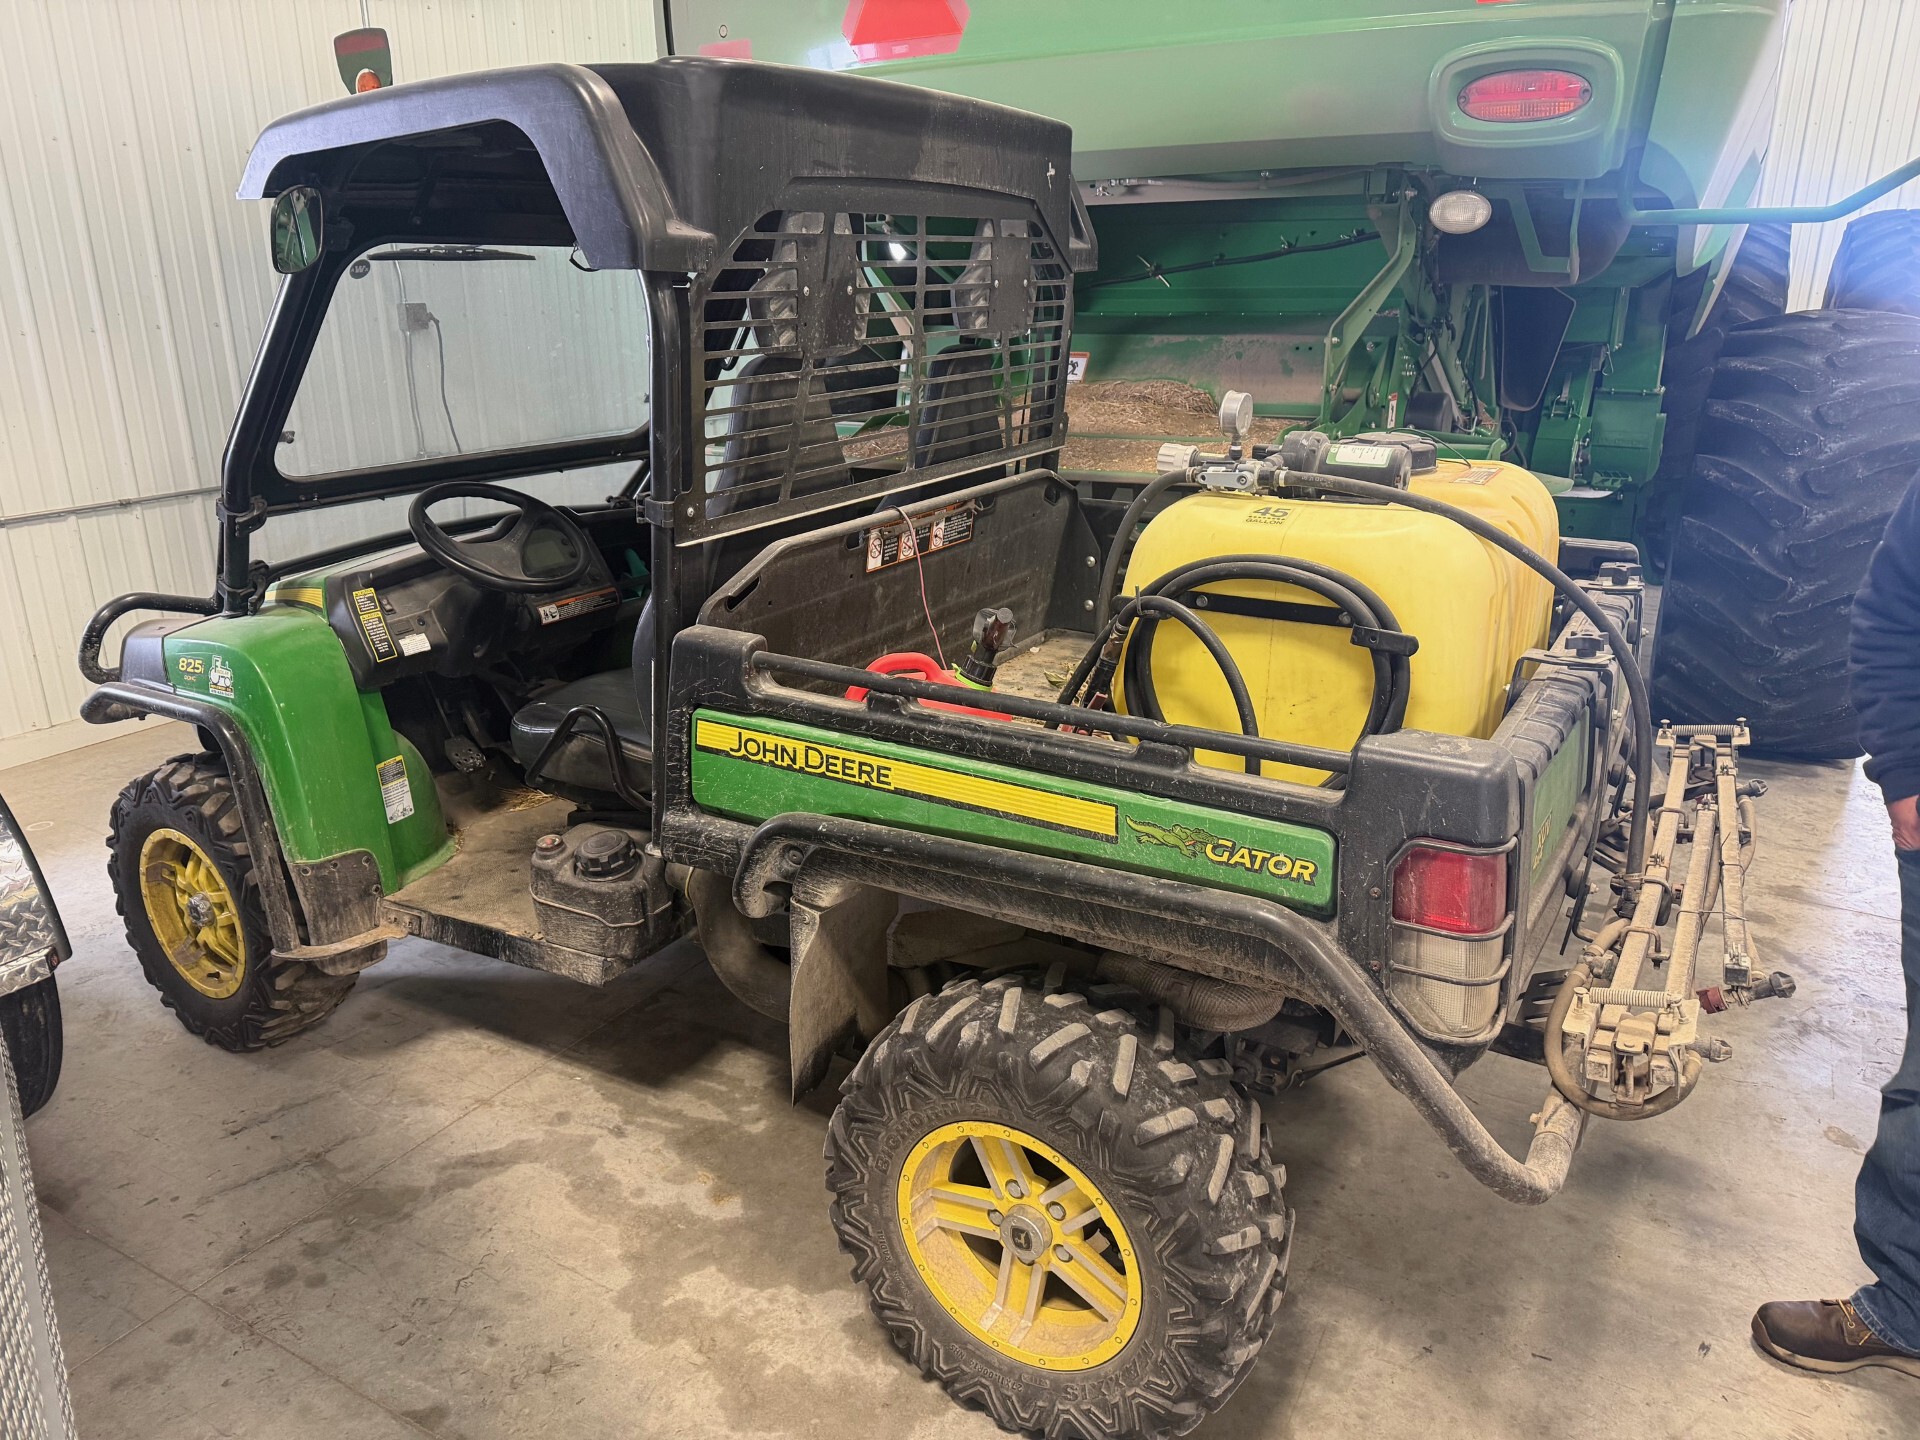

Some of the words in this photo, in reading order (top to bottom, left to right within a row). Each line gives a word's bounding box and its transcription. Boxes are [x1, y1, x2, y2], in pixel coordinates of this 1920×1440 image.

[1253, 506, 1291, 518] 45
[179, 657, 205, 674] 825i
[729, 731, 797, 766] JOHN
[804, 745, 892, 787] DEERE
[1205, 838, 1317, 883] GATOR
[874, 1101, 961, 1175] BIGHORN
